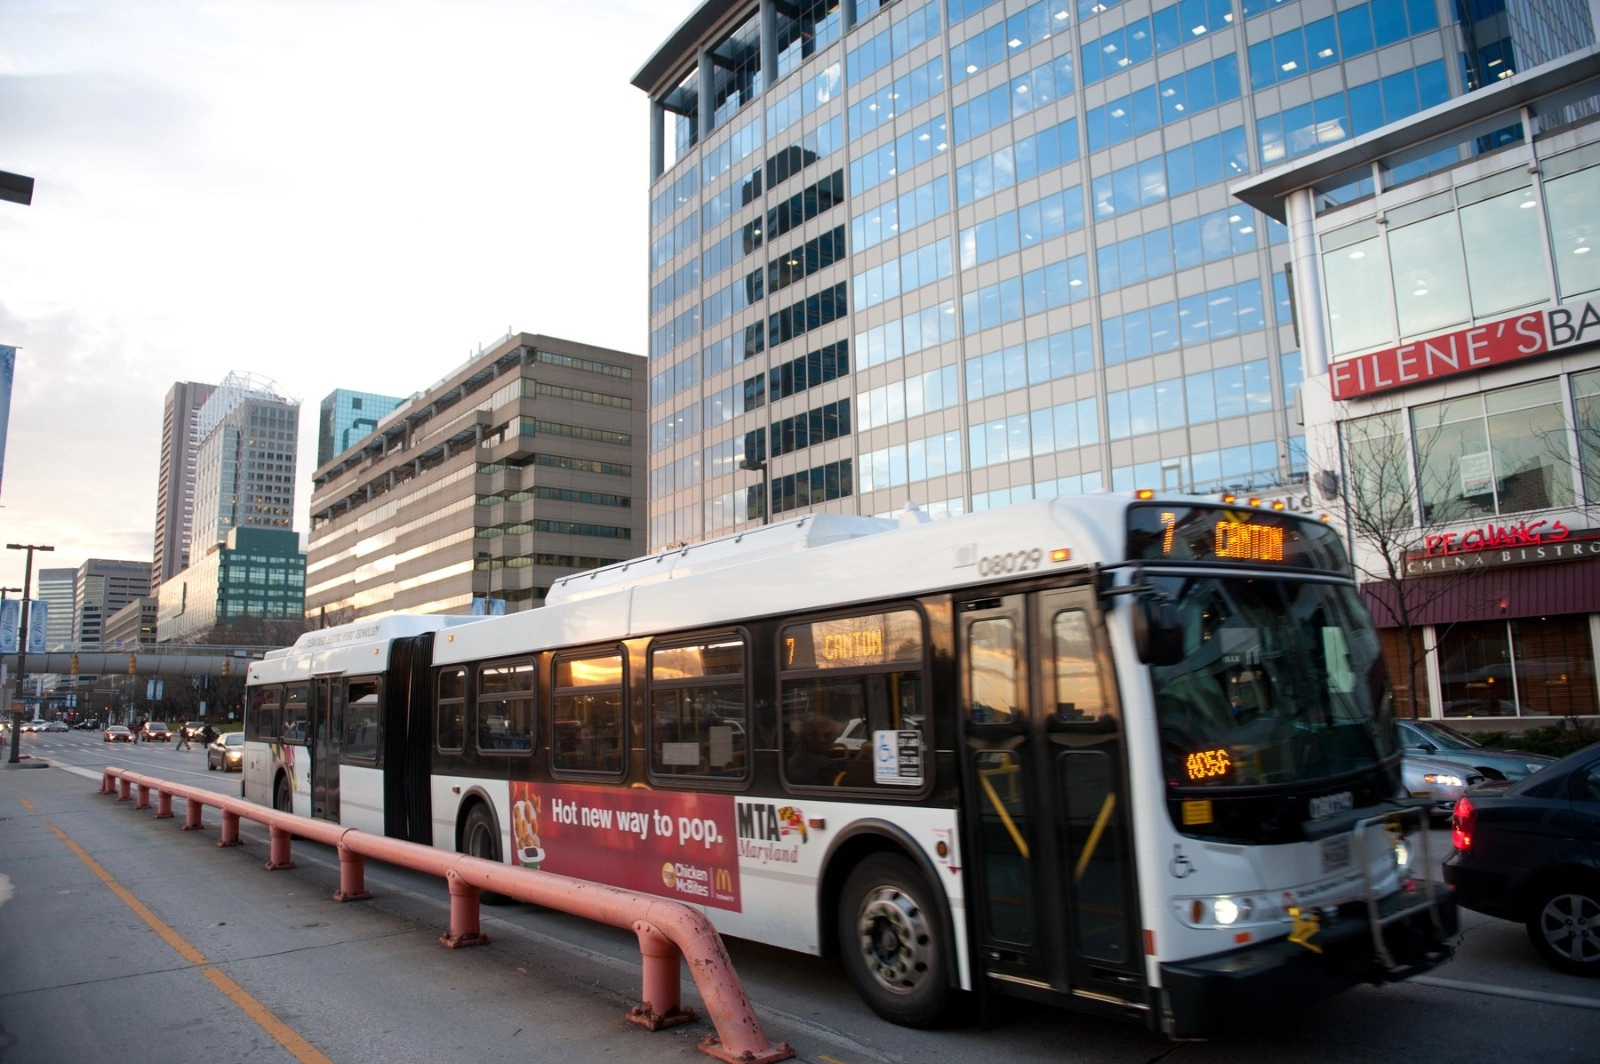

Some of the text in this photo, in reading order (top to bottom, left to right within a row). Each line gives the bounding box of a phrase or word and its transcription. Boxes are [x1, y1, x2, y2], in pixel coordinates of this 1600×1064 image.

[1331, 316, 1543, 397] FILENE'S
[1160, 512, 1176, 555] 7
[978, 547, 1043, 577] 08029
[1407, 542, 1600, 573] CHINA BISTRO
[786, 630, 883, 665] 7 CANTON
[1186, 749, 1231, 780] 4056
[552, 798, 723, 849] Hot new way to pop.
[737, 802, 781, 842] MTA
[738, 839, 799, 865] Maryland
[675, 862, 708, 882] Chicken
[676, 878, 710, 897] McBites
